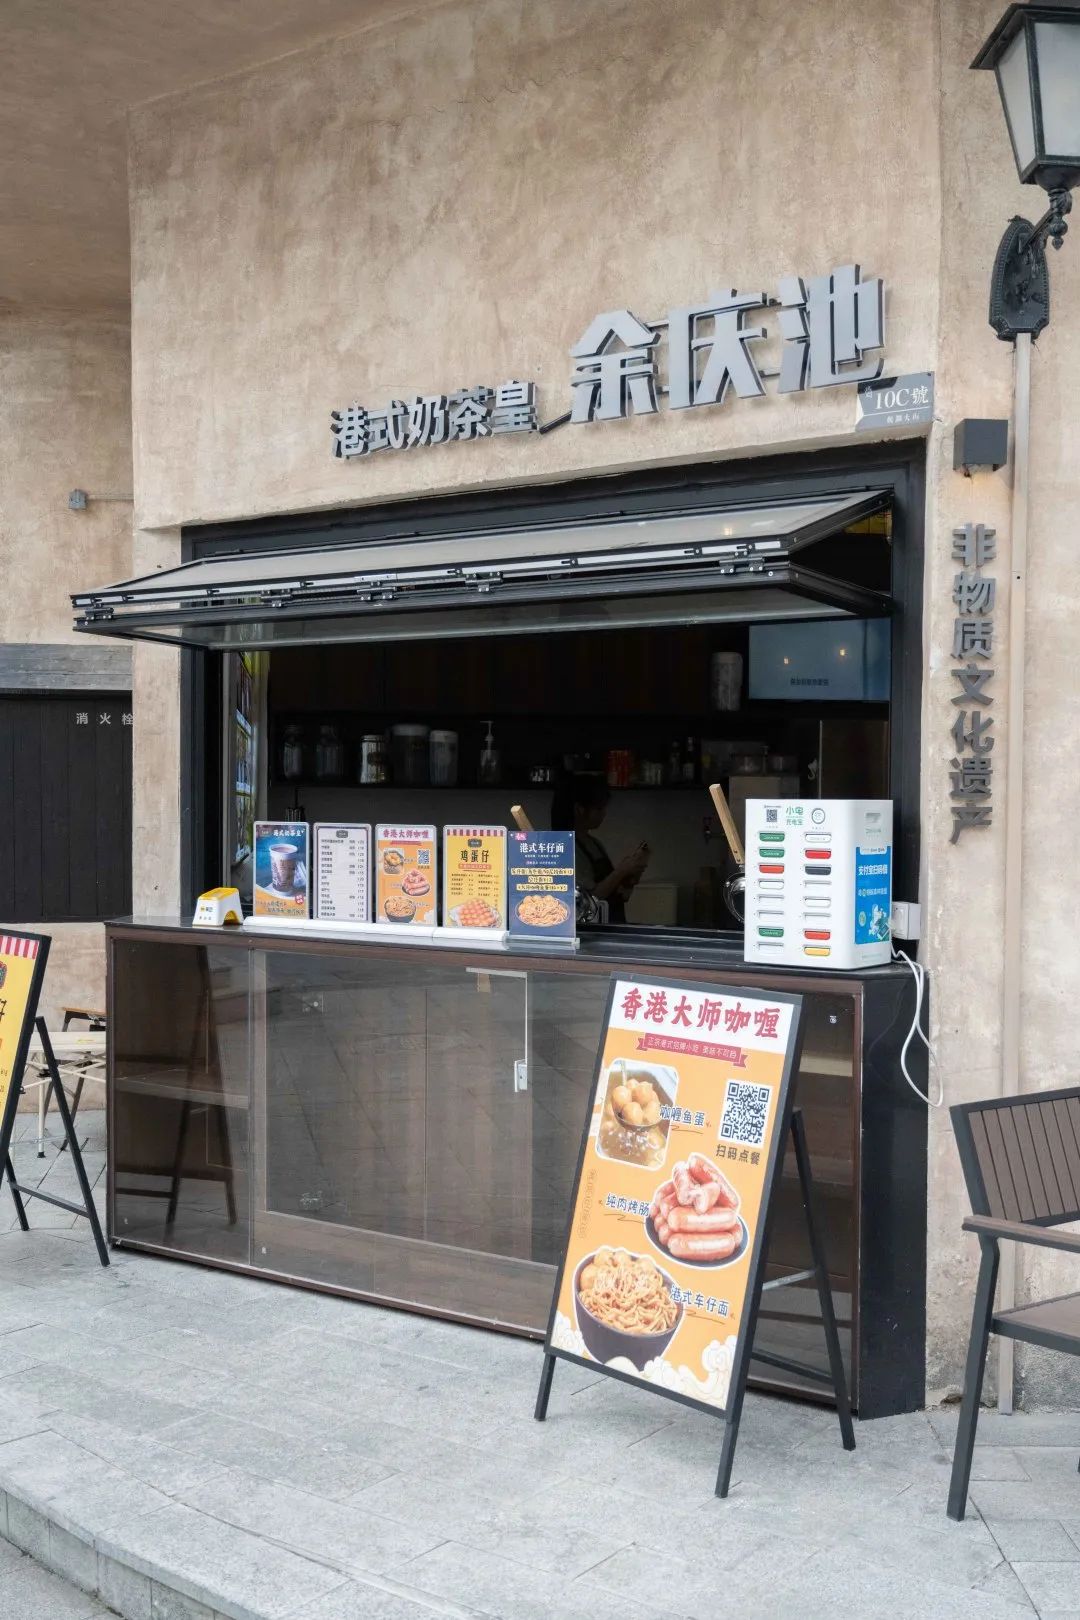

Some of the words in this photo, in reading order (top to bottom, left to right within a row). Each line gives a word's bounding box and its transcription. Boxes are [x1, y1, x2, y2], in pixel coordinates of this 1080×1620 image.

[571, 263, 886, 424] 余庆池
[875, 385, 929, 409] 10C號
[331, 379, 539, 459] 港式奶茶皇
[949, 522, 997, 845] 非物质文化遗产
[76, 712, 133, 726] 消火栓
[460, 850, 490, 863] 鸡蛋仔
[519, 842, 564, 854] 港式车仔面
[621, 988, 781, 1039] 香港大师咖喱
[660, 1104, 705, 1127] 咖喱鱼蛋
[715, 1144, 761, 1166] 扫码点餐
[605, 1193, 650, 1217] 纯肉烤肠
[670, 1284, 729, 1317] 港式车仔面
